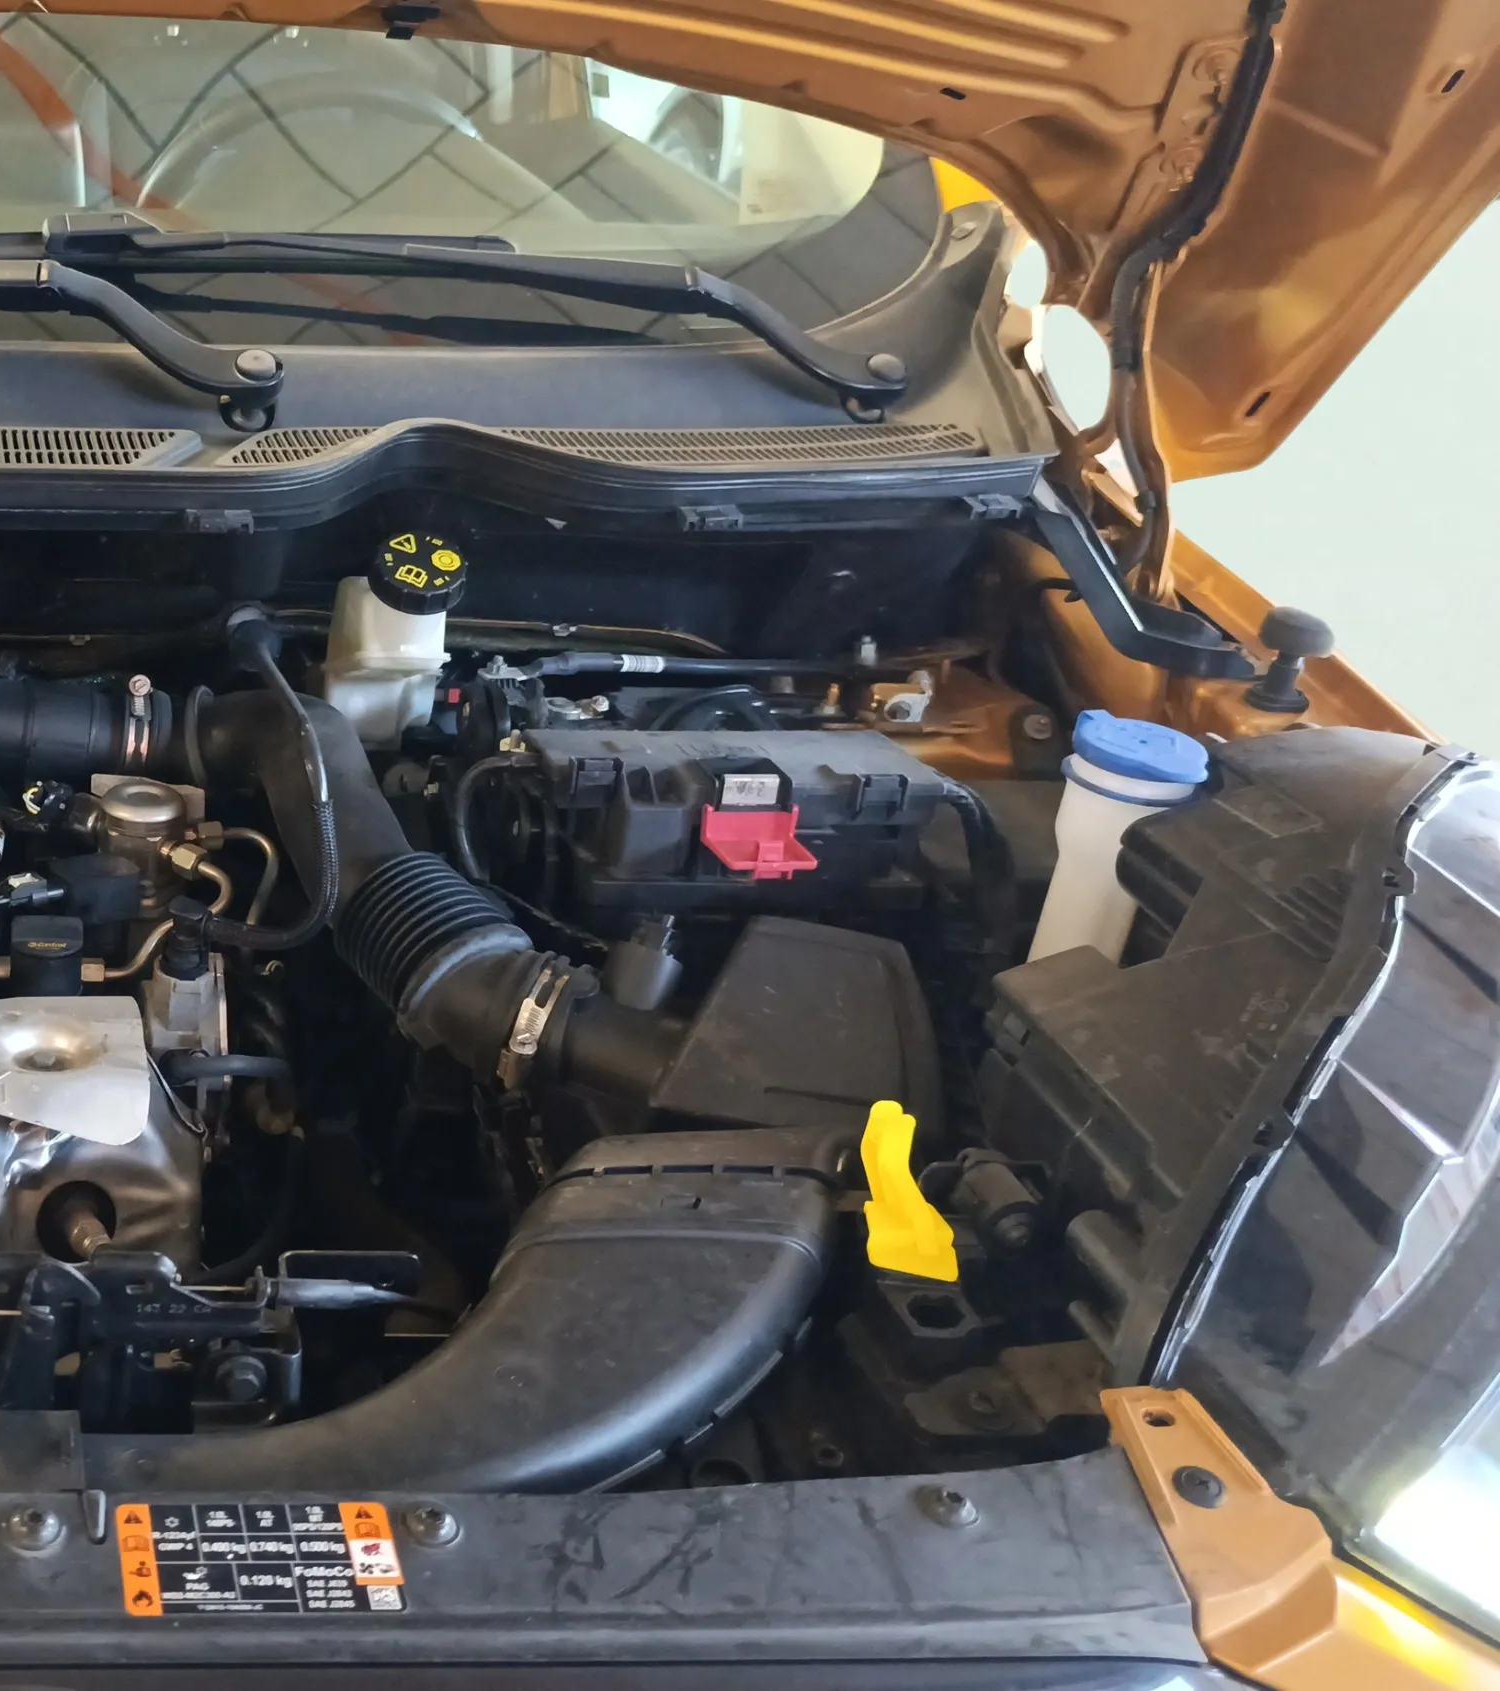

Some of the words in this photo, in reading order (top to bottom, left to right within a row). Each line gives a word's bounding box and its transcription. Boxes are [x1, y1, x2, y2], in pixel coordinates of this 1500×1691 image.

[279, 1541, 295, 1554] kg
[330, 1541, 345, 1554] kg
[295, 1566, 354, 1577] FoMoCo
[275, 1575, 293, 1588] kg
